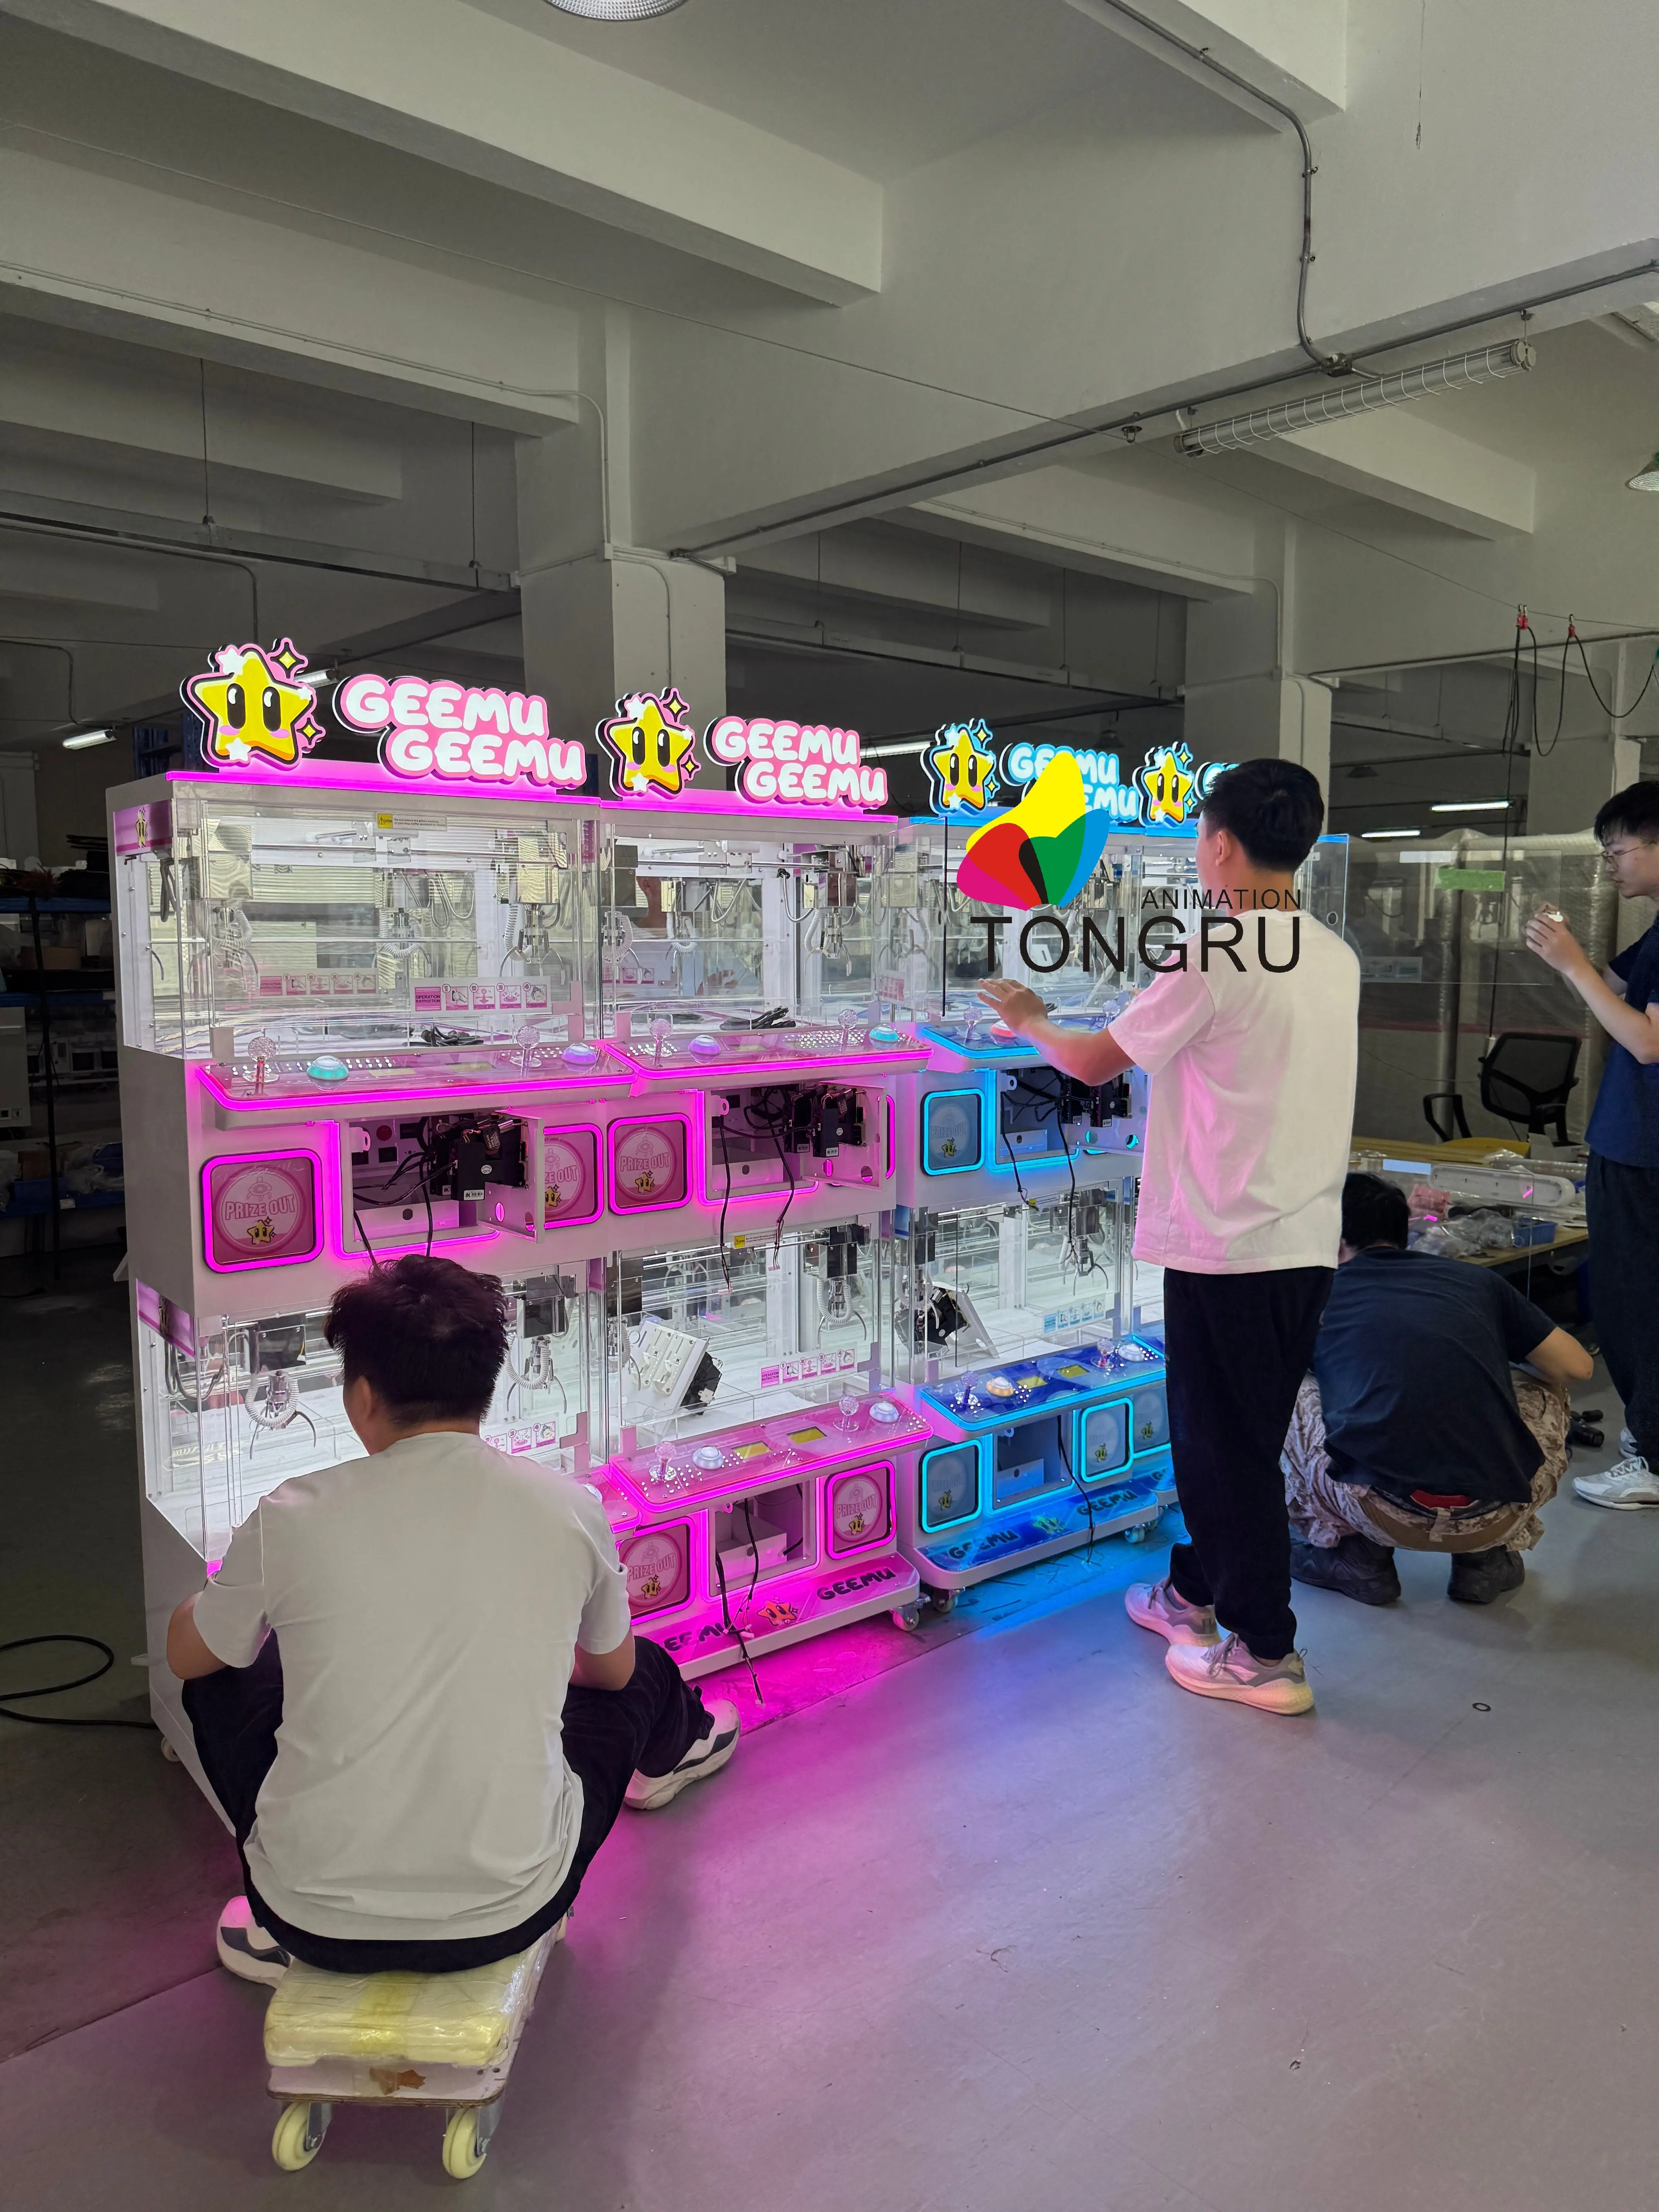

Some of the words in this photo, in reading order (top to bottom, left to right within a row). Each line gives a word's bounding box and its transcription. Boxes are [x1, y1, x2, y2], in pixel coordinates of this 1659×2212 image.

[346, 680, 544, 736] GEEMU
[391, 729, 581, 780] GEEMU
[714, 721, 857, 764] GEEMU
[1011, 747, 1117, 784] GEMU
[747, 761, 884, 802] GEEMU
[557, 1165, 577, 1182] OUT
[620, 1156, 649, 1171] PRIZE
[651, 1152, 669, 1169] OUT
[225, 1202, 267, 1220] PRIZE
[269, 1195, 295, 1214] OUT
[836, 1503, 860, 1518] PRIZE
[861, 1494, 876, 1511] OUT
[1077, 1490, 1139, 1515] GEEMU
[627, 1563, 655, 1582] PRIZE
[656, 1553, 675, 1572] OUT
[817, 1567, 896, 1600] GEEMU
